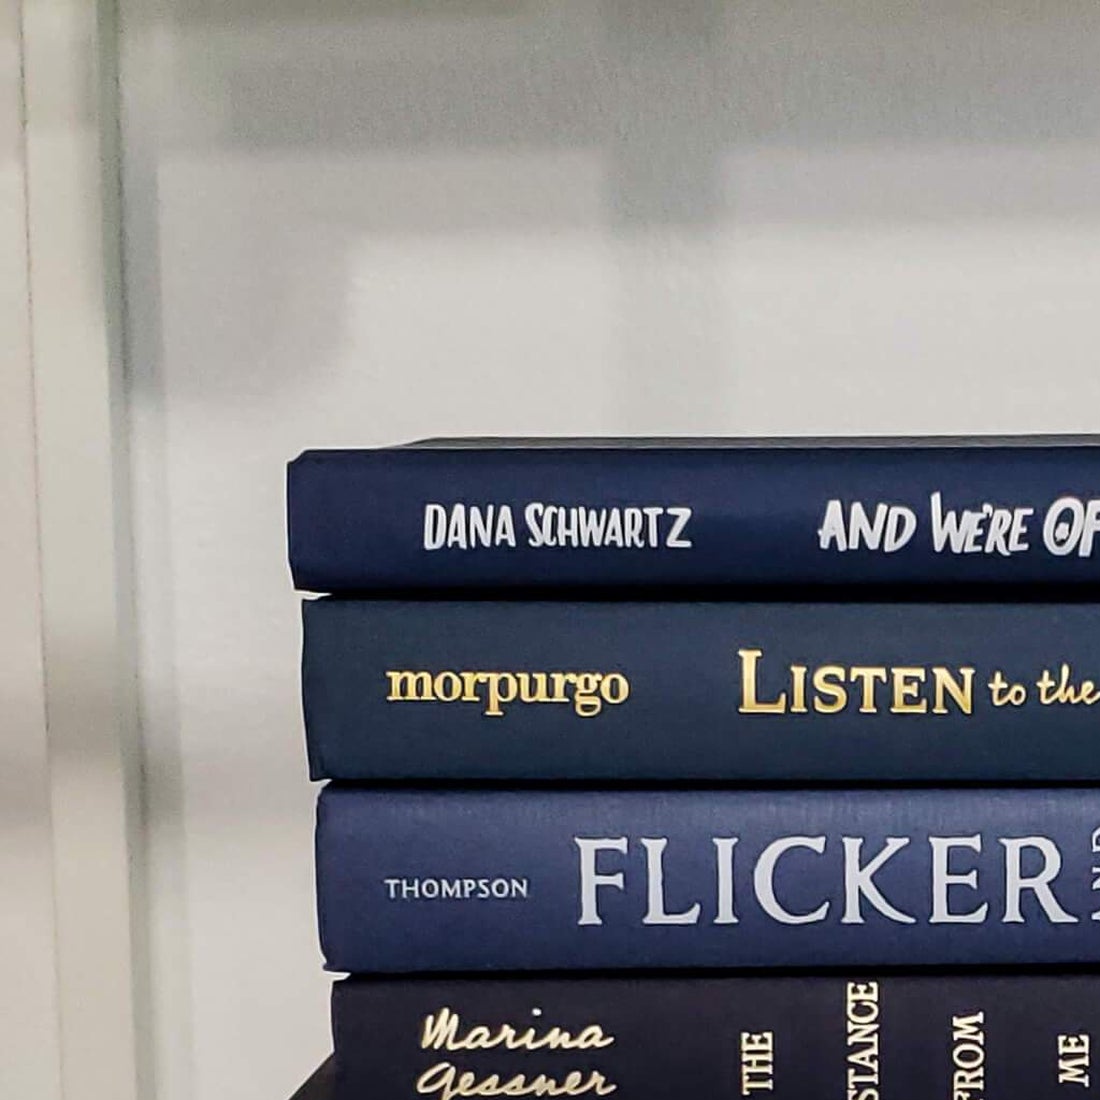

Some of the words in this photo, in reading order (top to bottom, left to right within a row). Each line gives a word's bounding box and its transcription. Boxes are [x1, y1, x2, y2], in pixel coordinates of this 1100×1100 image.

[423, 503, 516, 551] DANA
[524, 502, 692, 548] SCHWARTZ
[817, 499, 917, 553] AND
[385, 670, 629, 717] morpurgo
[737, 649, 976, 714] LISTEN
[987, 671, 1027, 706] to
[384, 878, 528, 899] THOMPSON
[577, 836, 1077, 925] FLICKER
[421, 1007, 615, 1051] Marina
[740, 1031, 774, 1096] THE
[1057, 1034, 1090, 1088] ME
